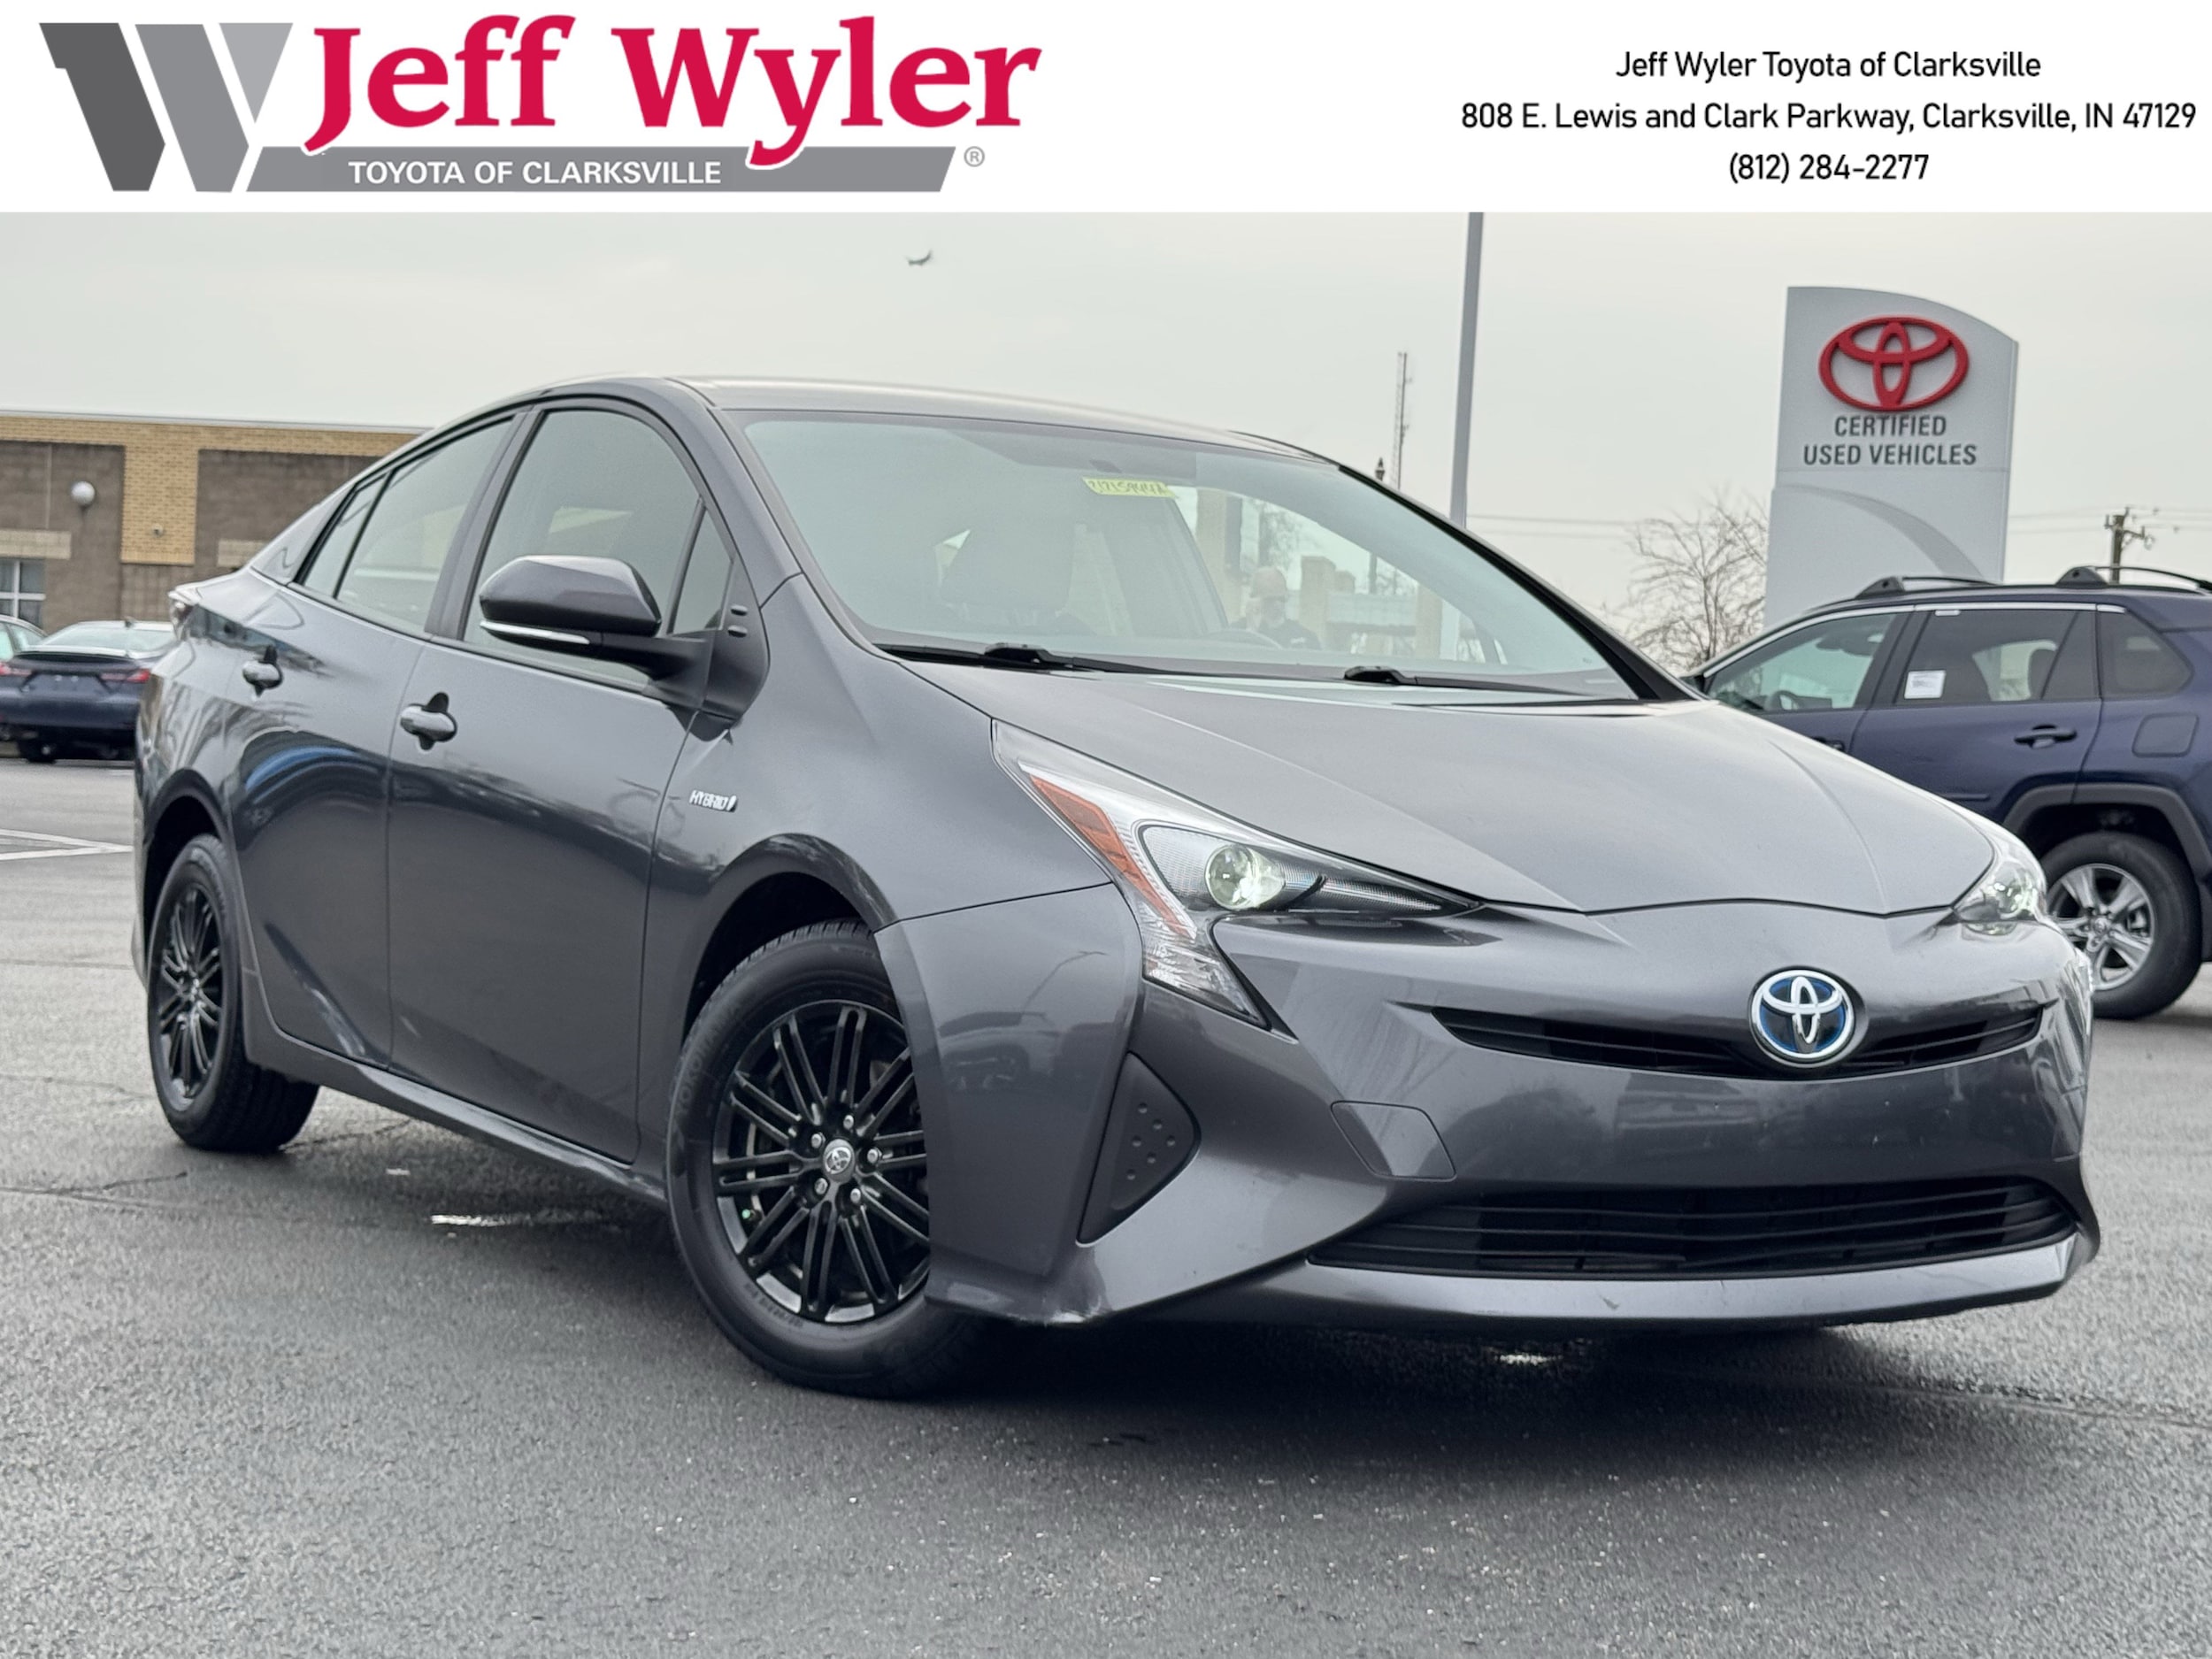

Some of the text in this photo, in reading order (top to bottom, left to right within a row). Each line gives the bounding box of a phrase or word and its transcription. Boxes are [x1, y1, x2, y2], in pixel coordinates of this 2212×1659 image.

[1834, 414, 1947, 436] CERTIFIED
[1803, 444, 1978, 465] USED VEHICLES
[689, 789, 729, 810] HYBRID
